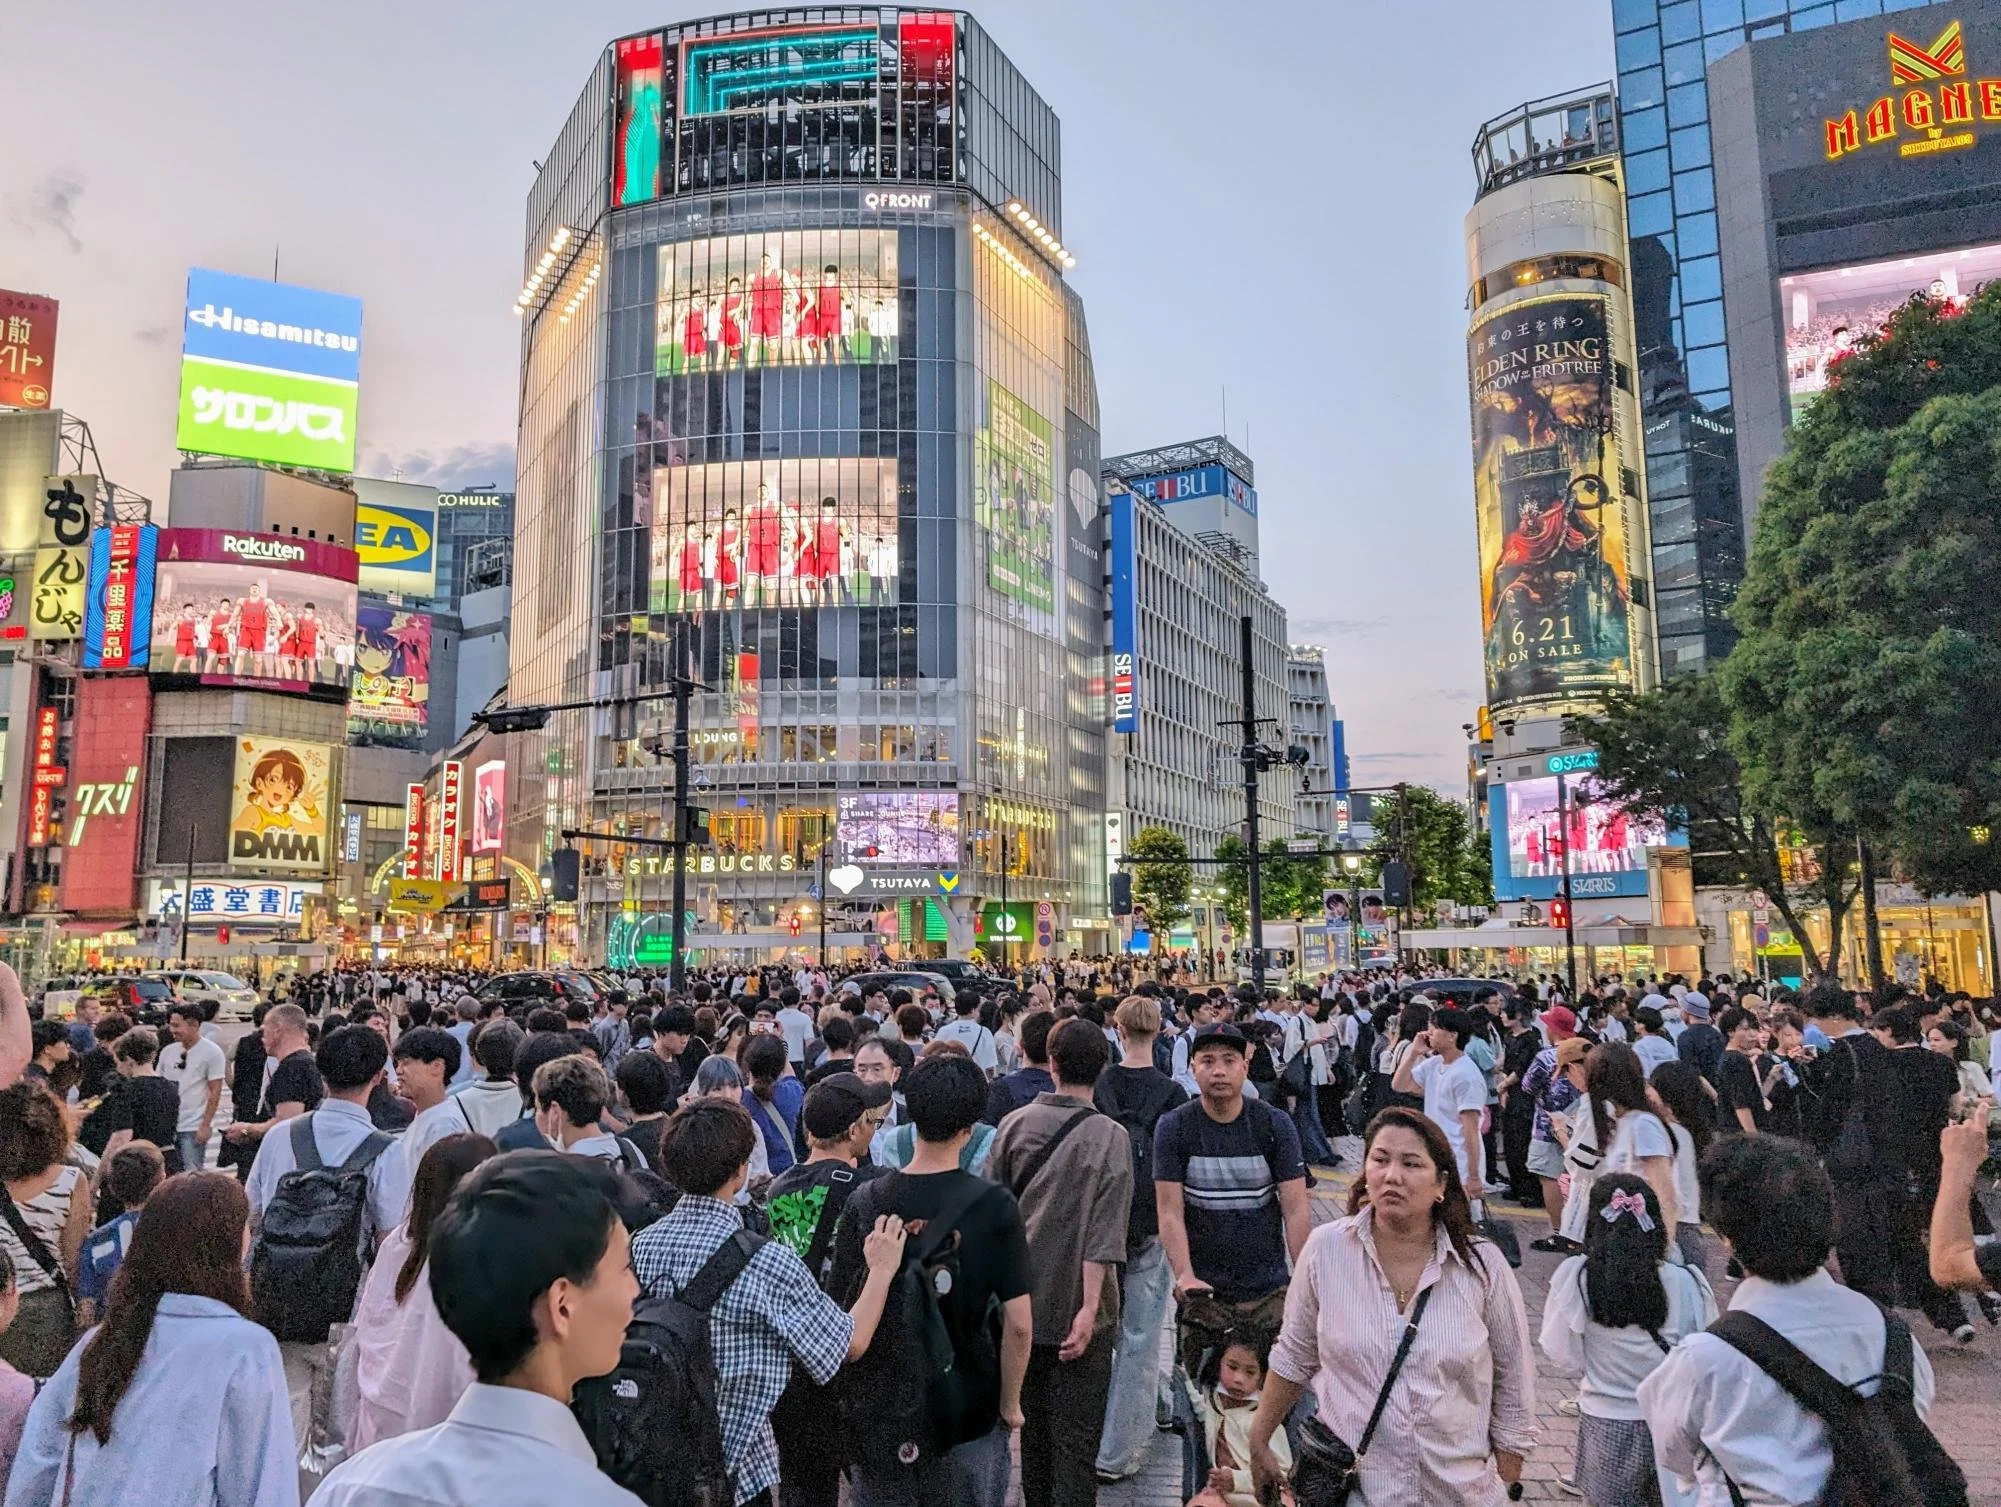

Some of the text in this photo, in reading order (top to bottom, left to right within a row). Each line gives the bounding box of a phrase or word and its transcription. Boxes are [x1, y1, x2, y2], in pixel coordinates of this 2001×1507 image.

[865, 193, 931, 209] QFRONT
[189, 304, 357, 352] Hisamitsu
[1474, 337, 1600, 391] ELDEN RING
[1532, 361, 1602, 378] ERDTREE
[191, 385, 345, 444] サロンパス
[459, 496, 500, 506] HULIC
[224, 535, 305, 562] Rakuten
[357, 522, 418, 552] EA
[1071, 537, 1098, 560] TSUTAYA
[36, 479, 90, 634] もんじゃ
[103, 532, 132, 658] 三千里薬品
[1512, 616, 1574, 646] 6.21
[1509, 644, 1583, 663] ON SALE
[1115, 653, 1133, 720] SEIBU
[69, 766, 139, 846] クスリ
[444, 770, 458, 828] カラオケ
[840, 797, 858, 809] 3F
[1336, 800, 1348, 833] SEIBU
[234, 830, 320, 862] DMM
[629, 855, 793, 875] STARBUCKS
[870, 878, 931, 889] TSUTAYA
